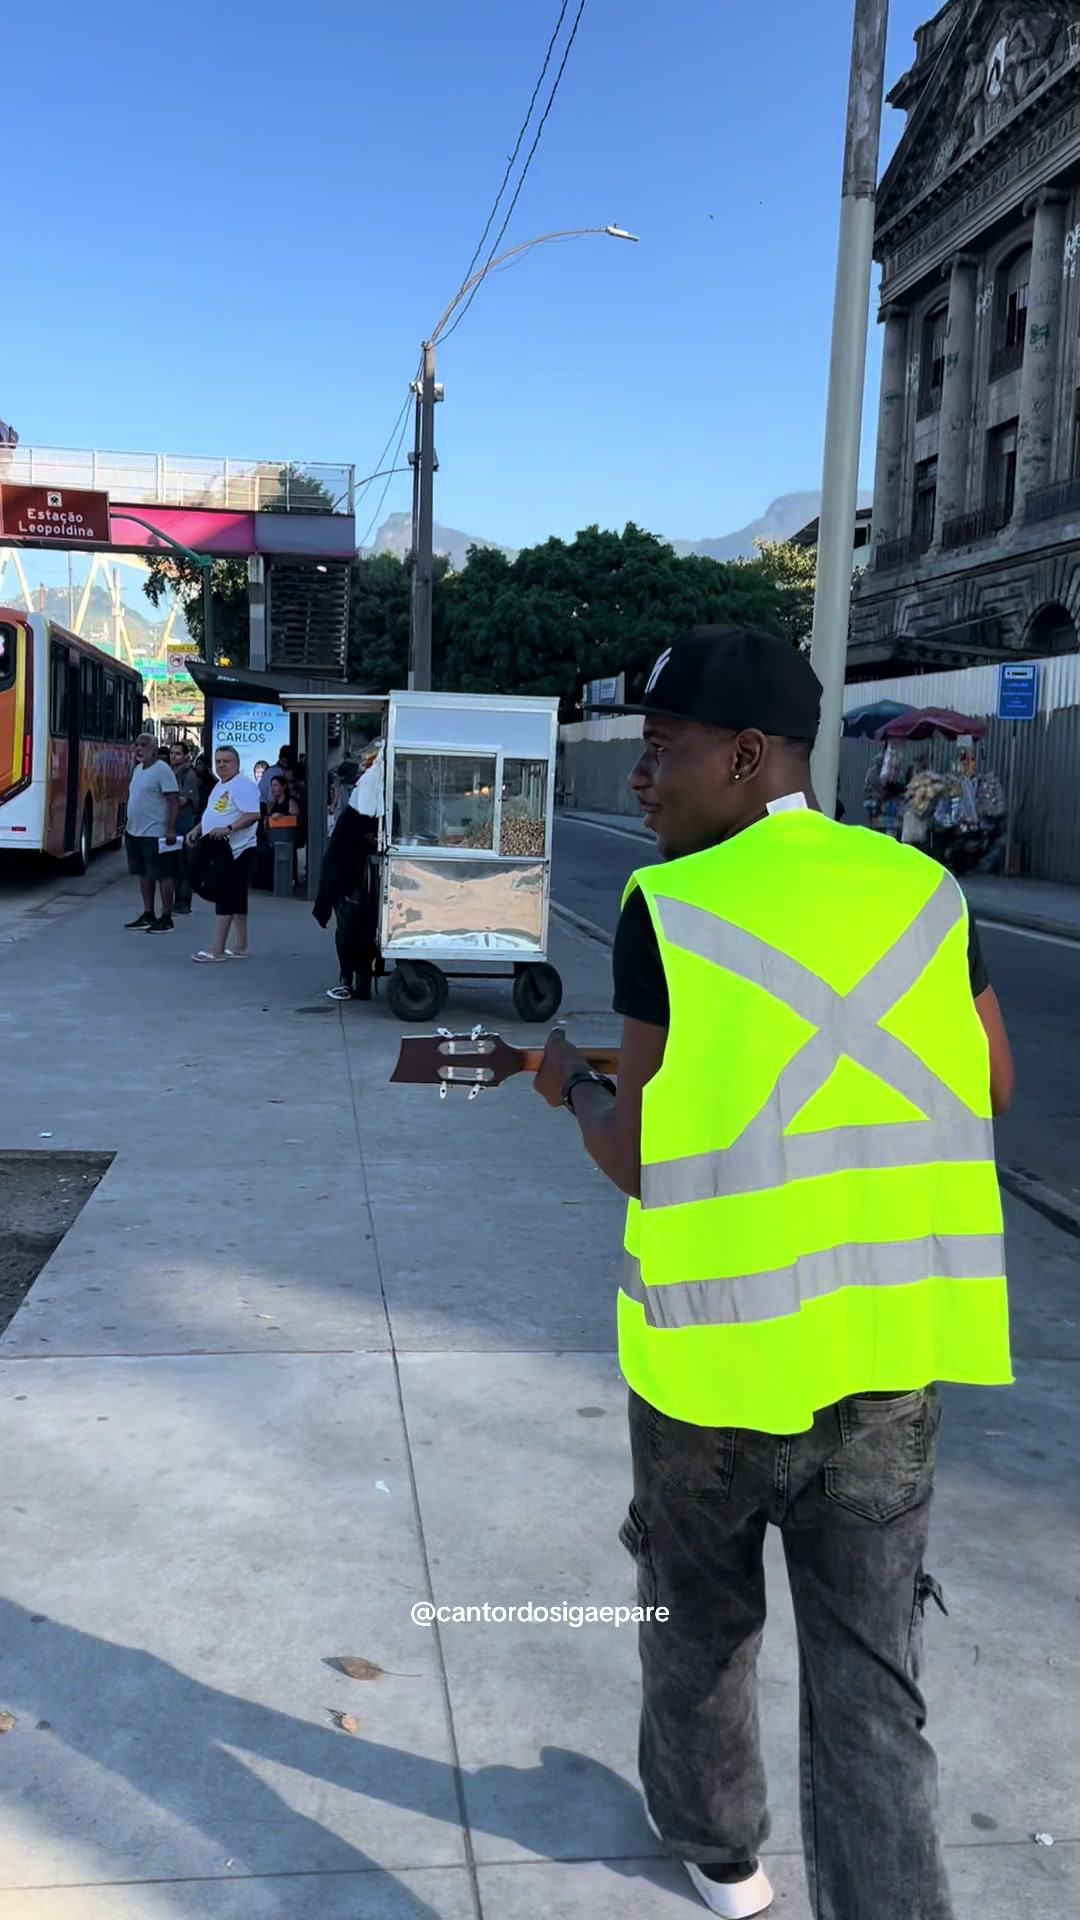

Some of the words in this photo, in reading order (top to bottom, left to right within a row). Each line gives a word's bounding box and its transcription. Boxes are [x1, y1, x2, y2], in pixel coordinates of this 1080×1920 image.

[966, 167, 1010, 216] FERRO
[27, 508, 83, 524] Estação
[18, 520, 94, 537] Leopoldina
[216, 720, 274, 732] ROBERTO
[216, 731, 266, 743] CARLOS
